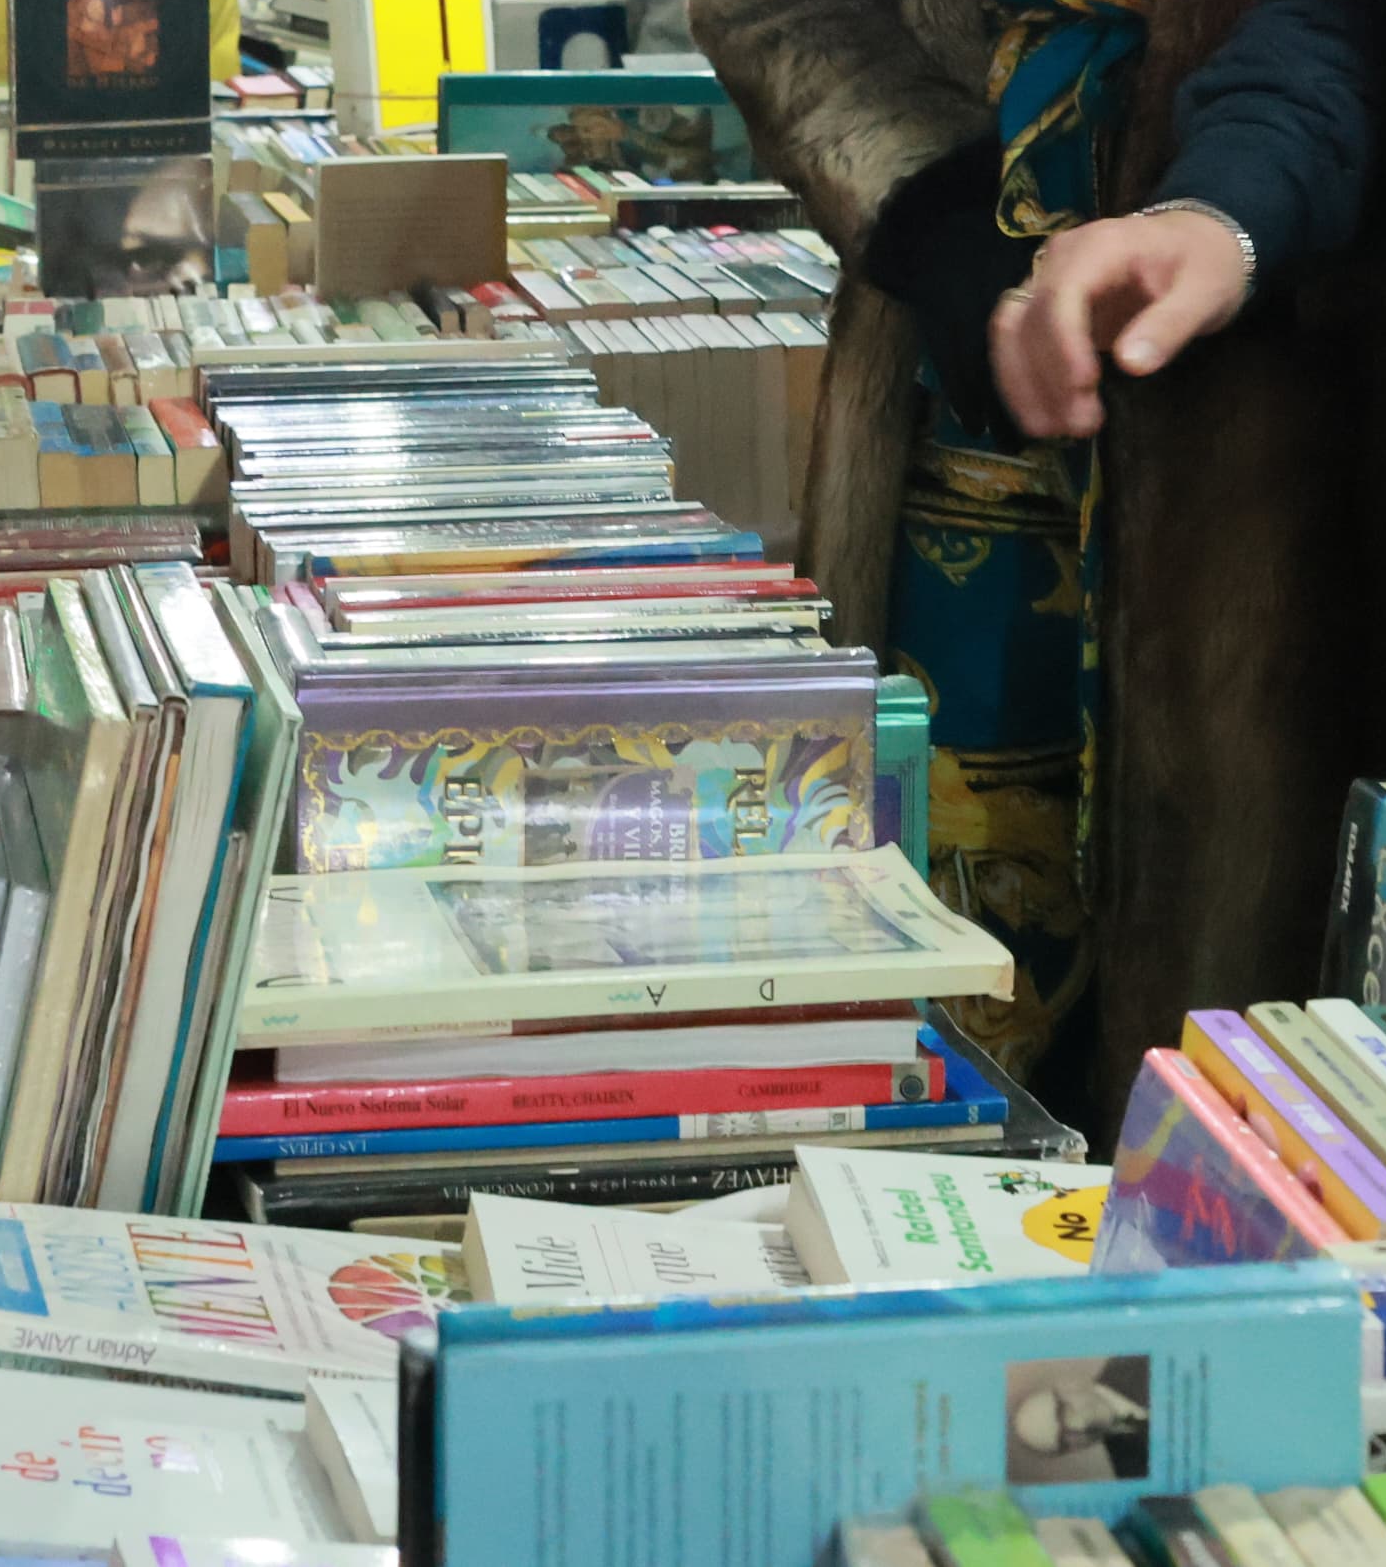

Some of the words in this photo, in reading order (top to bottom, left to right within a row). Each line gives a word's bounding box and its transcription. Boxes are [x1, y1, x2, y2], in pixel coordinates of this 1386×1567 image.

[284, 1098, 300, 1117] El
[306, 1097, 355, 1116] Nuevo
[359, 1095, 422, 1114] Sistema
[426, 1093, 467, 1113] Solar
[737, 1079, 823, 1099] CAMBRIDGE
[339, 1140, 368, 1154] LAS
[904, 1188, 939, 1246] Rafael
[927, 1172, 992, 1274] Santandreu
[526, 1234, 580, 1292] Mide
[643, 1239, 715, 1286] que
[124, 1222, 286, 1352] MENTE
[12, 1326, 81, 1351] JAIME
[83, 1338, 158, 1367] Adrián
[0, 1450, 61, 1484] de
[58, 1425, 133, 1498] decir
